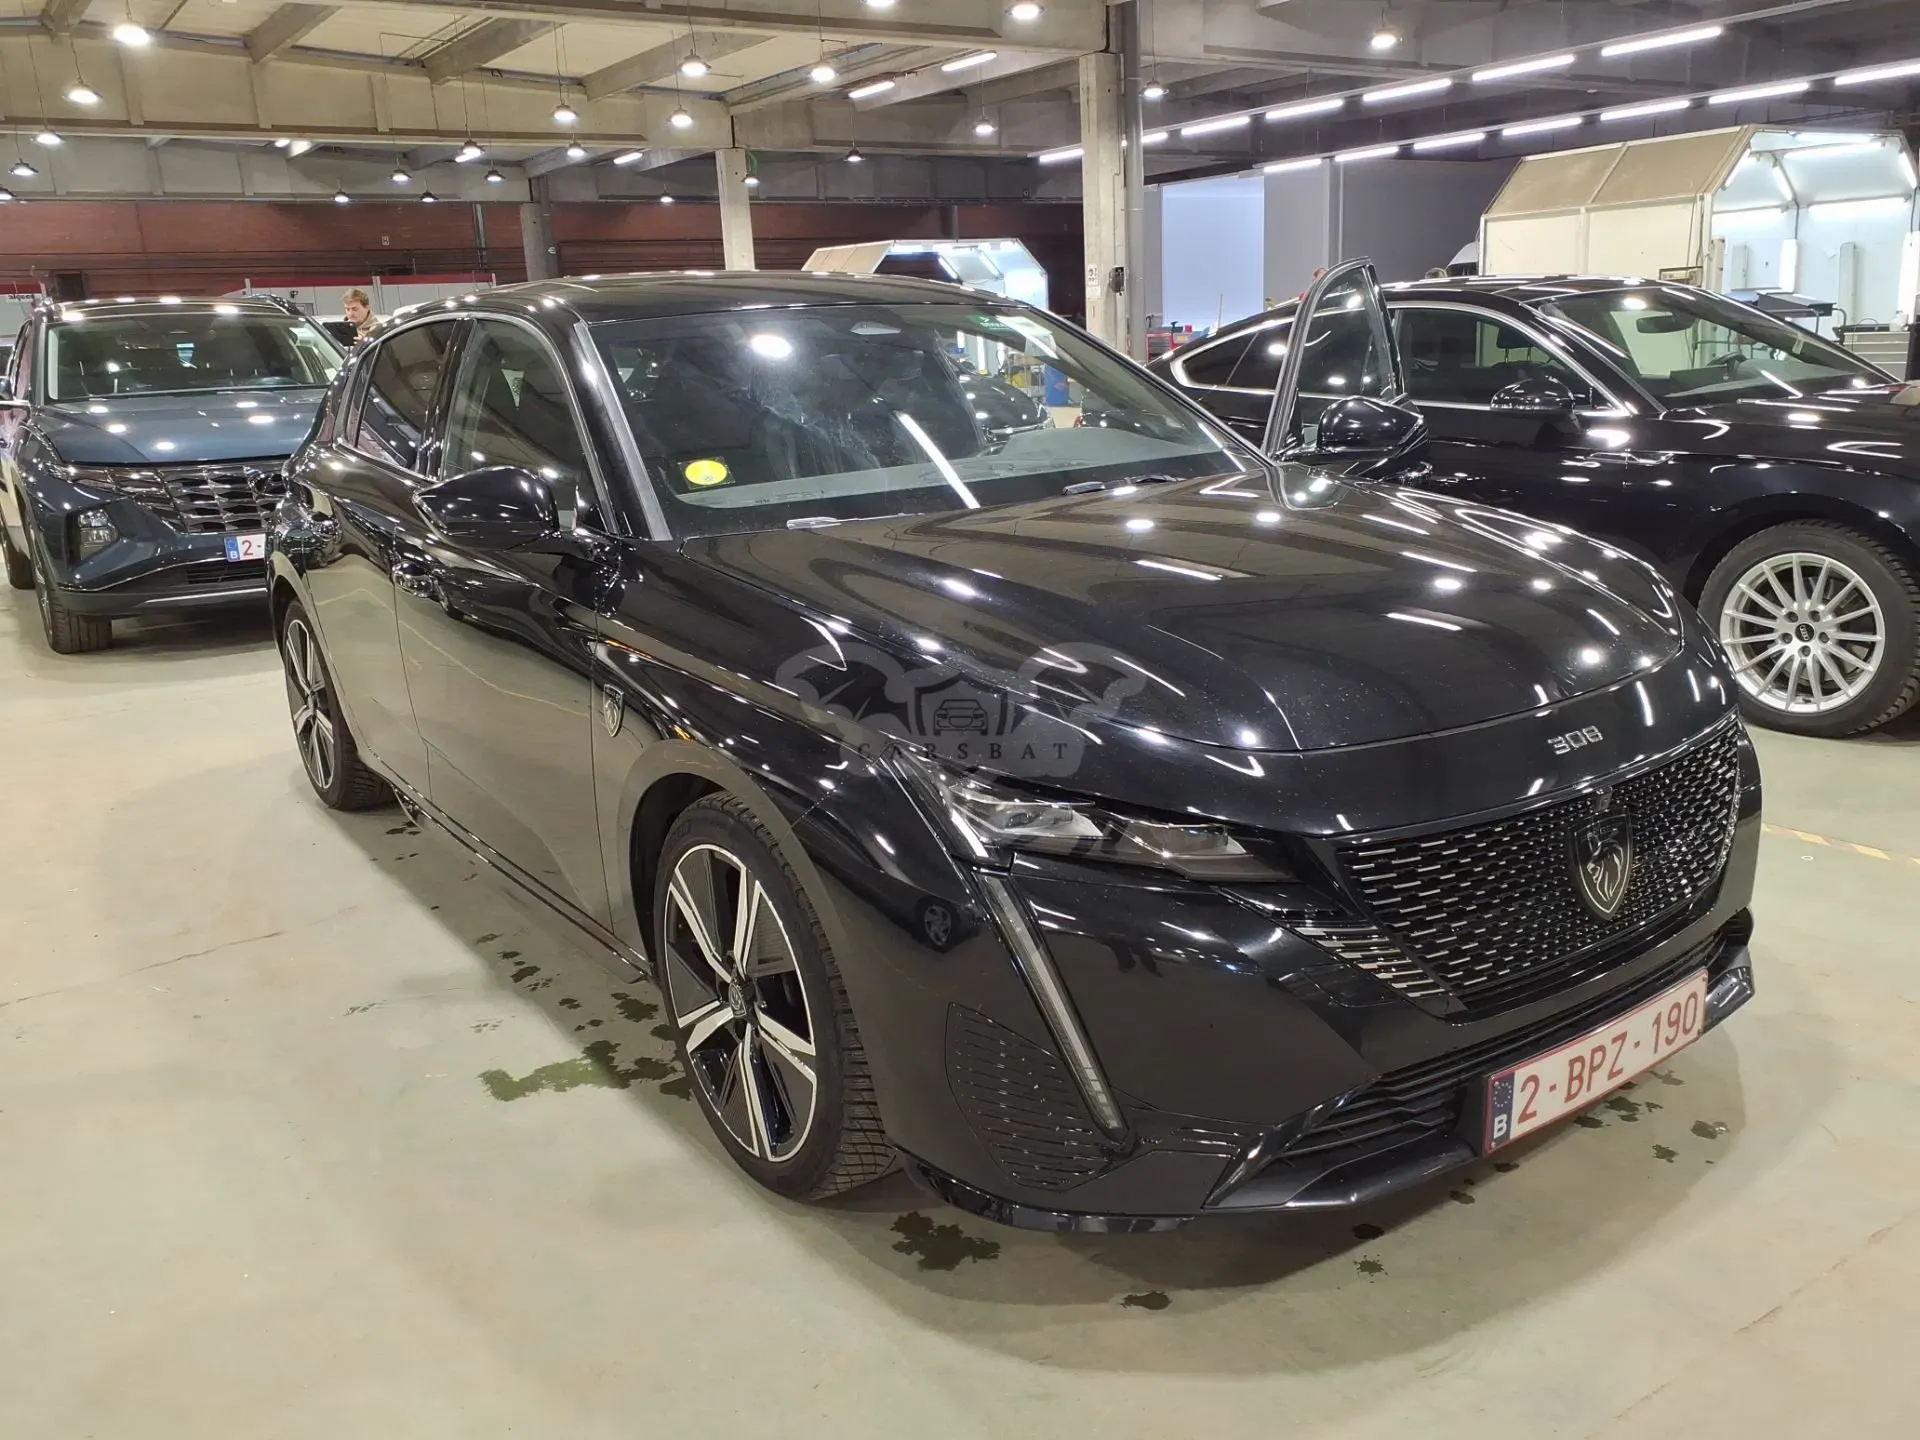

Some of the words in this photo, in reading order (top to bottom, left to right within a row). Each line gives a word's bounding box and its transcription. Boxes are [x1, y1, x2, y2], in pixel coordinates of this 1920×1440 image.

[1547, 725, 1603, 755] 308
[1517, 991, 1699, 1125] 2-BPZ-190
[1493, 1114, 1508, 1139] B
